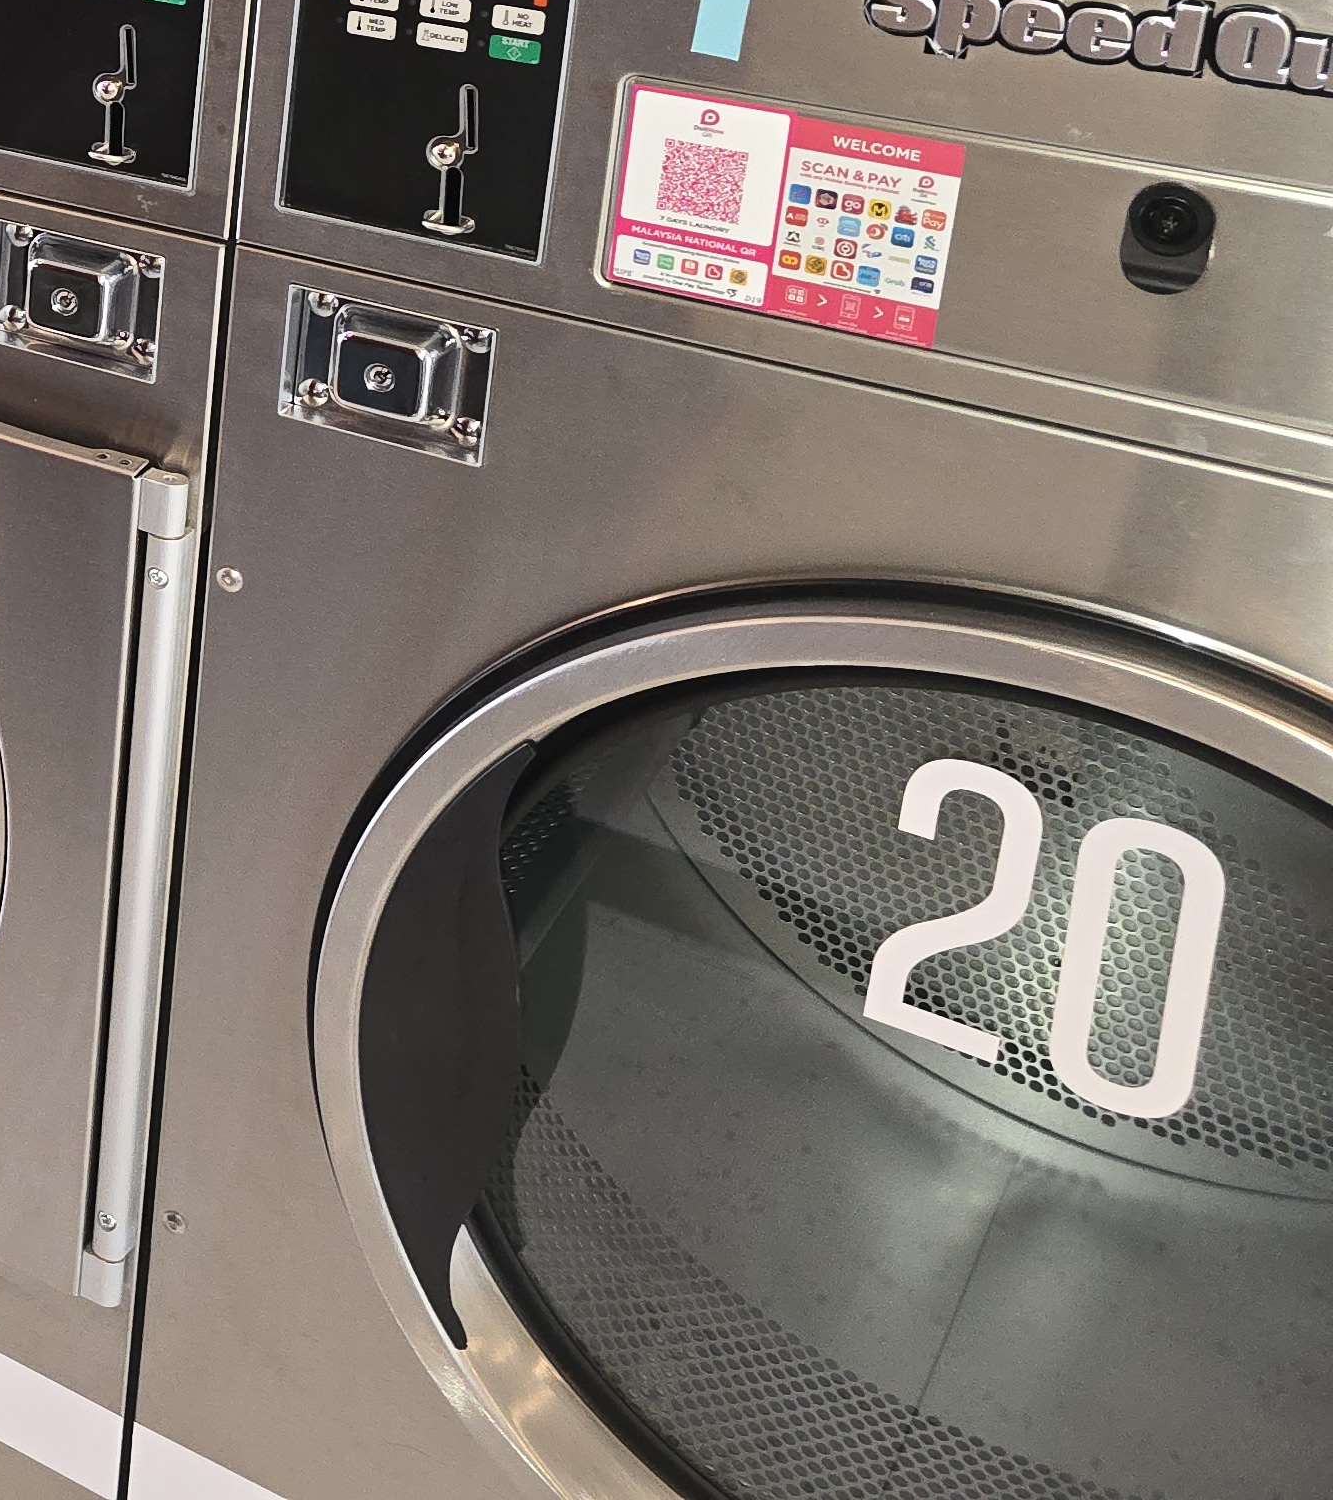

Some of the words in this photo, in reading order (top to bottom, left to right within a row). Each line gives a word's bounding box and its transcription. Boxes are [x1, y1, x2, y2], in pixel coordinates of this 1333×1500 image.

[440, 0, 459, 9] LOW
[438, 7, 461, 17] TEMP
[516, 12, 530, 21] NO
[368, 18, 386, 26] MED
[511, 19, 534, 29] HEAT
[365, 24, 386, 33] TEMP
[429, 32, 465, 44] DELICATE
[832, 135, 922, 163] WELCOME
[800, 160, 850, 179] SCAN
[852, 170, 864, 182] &
[867, 172, 902, 189] PAY
[631, 225, 683, 242] MALAYSIA
[684, 235, 738, 253] NATIONAL
[740, 247, 757, 257] QR
[863, 758, 1226, 1119] 20
